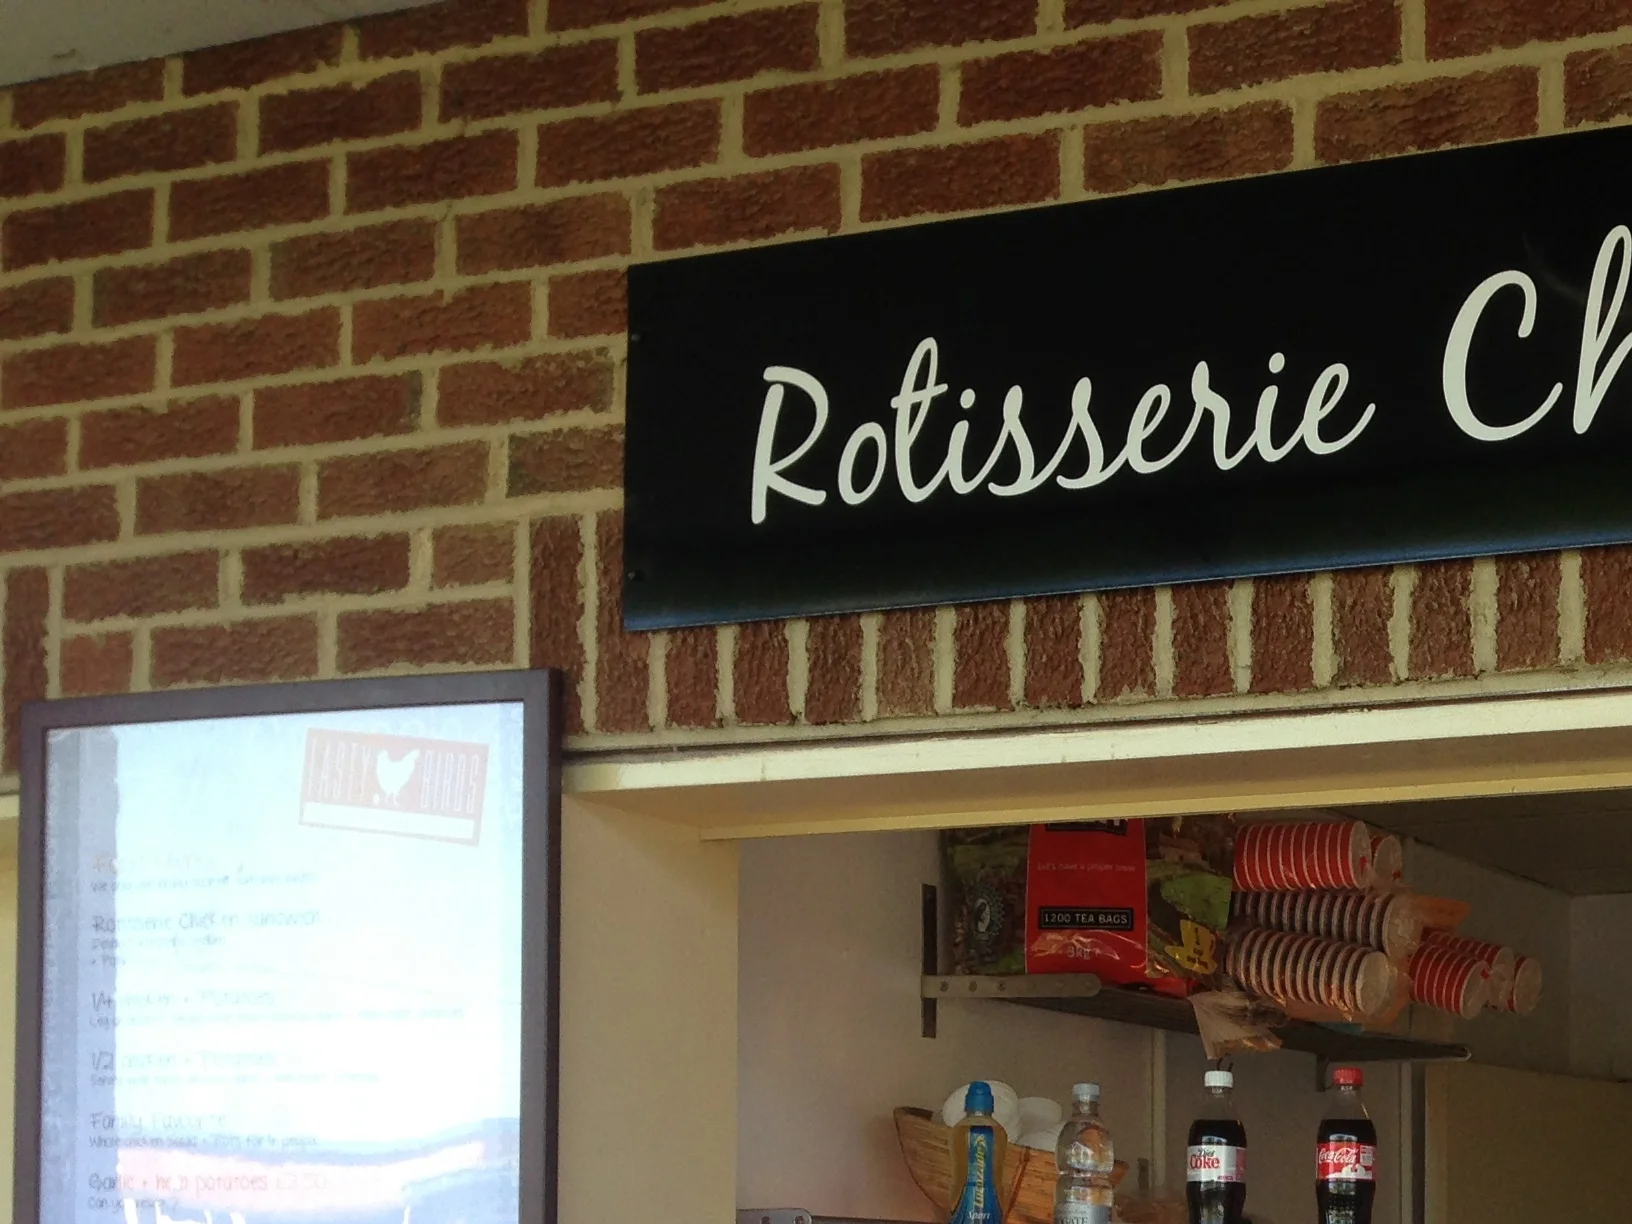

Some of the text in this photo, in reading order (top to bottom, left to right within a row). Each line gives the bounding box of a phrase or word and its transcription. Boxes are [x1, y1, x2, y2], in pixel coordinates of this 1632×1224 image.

[752, 337, 1375, 524] Rotisserie
[307, 738, 479, 813] TASTY BIRDS
[1044, 913, 1128, 925] 1200 TEA BAGS
[1190, 1154, 1220, 1169] Coke
[156, 1173, 188, 1191] heb
[194, 1174, 268, 1195] potatoes
